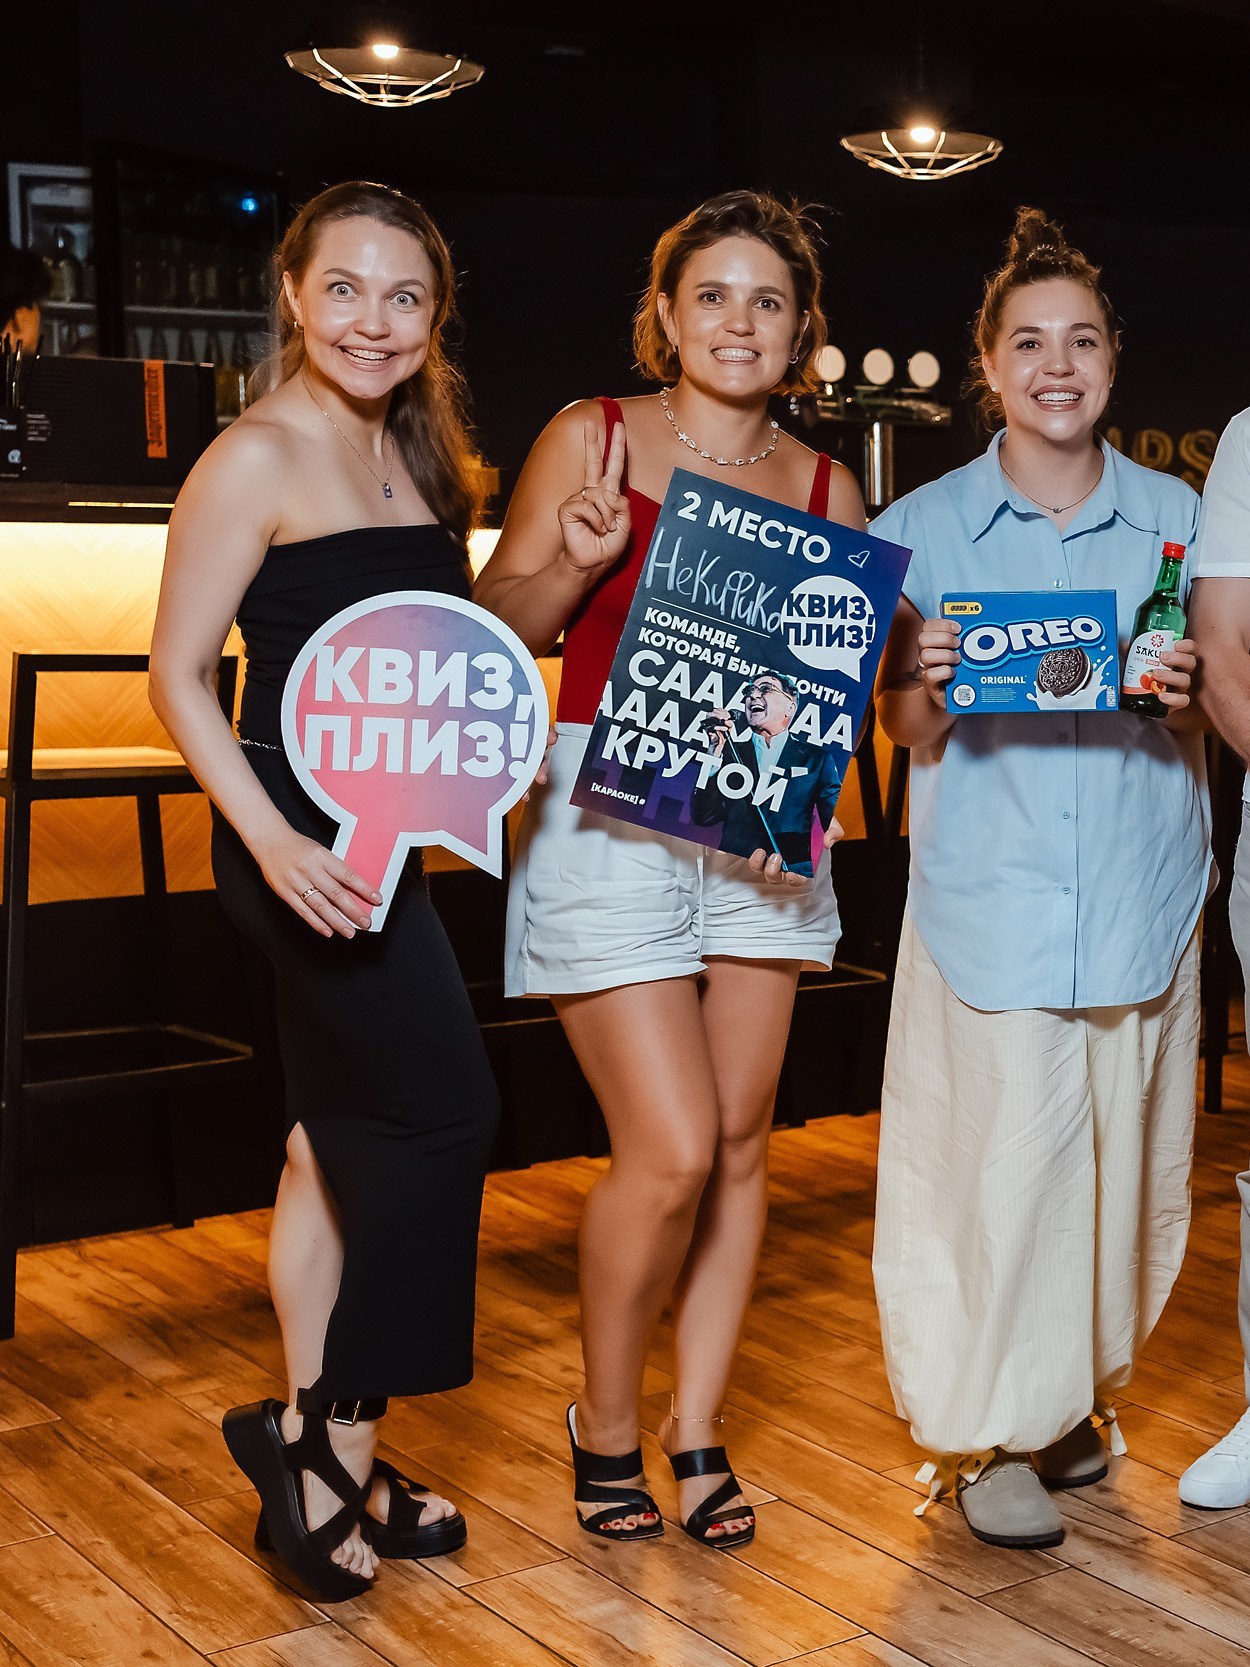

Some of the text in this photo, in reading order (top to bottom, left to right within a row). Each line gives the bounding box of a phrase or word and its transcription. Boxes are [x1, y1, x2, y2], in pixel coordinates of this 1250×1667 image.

[677, 491, 831, 564] 2 МЕСТО
[638, 627, 728, 668] КОТОРАЯ
[644, 607, 741, 654] КОМАНДЕ,
[783, 621, 874, 649] ПЛИЗ!
[963, 617, 1101, 661] OREO
[314, 645, 534, 721] КВИЗ,
[980, 675, 1026, 684] ORIGINAL
[303, 714, 529, 778] ПЛИЗ!
[601, 724, 788, 812] КРУТОЙ
[591, 782, 639, 805] [КАРАОКЕ]
